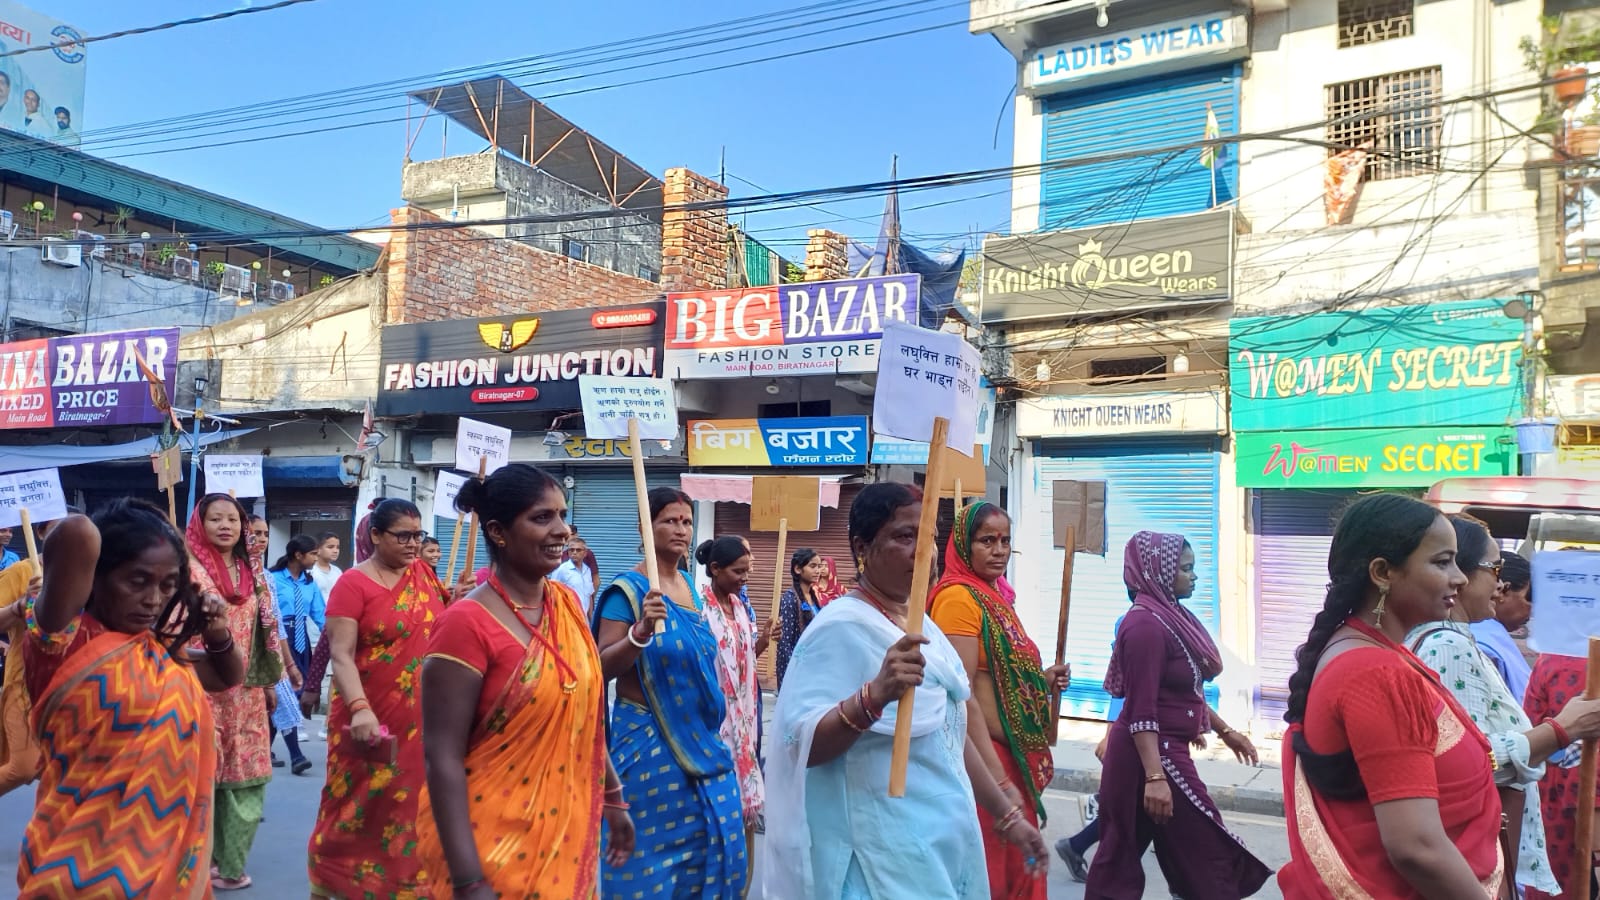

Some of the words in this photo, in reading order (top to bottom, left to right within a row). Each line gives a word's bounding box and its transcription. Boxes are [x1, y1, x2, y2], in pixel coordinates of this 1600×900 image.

[1038, 36, 1133, 77] LADIES
[1140, 18, 1226, 56] WEAR
[988, 262, 1069, 295] Knight
[1070, 249, 1193, 290] Queen
[671, 292, 775, 344] BIG
[786, 281, 909, 339] BAZAR
[0, 349, 48, 390] INA
[52, 337, 168, 387] BAZAR
[698, 348, 789, 363] FASHION
[802, 343, 876, 359] STORE
[725, 363, 747, 372] MAIN
[900, 344, 940, 363] लघुवित्त
[1387, 333, 1525, 392] SECRET
[383, 357, 498, 391] FASHION
[504, 347, 657, 384] JUNCTION
[903, 366, 920, 380] घर
[56, 389, 119, 409] PRICE
[6, 412, 26, 423] Main
[27, 411, 48, 423] Road
[58, 409, 111, 423] Biratnagar-7
[1053, 406, 1093, 428] KNIGHT
[1095, 405, 1131, 427] QUEEN
[1134, 402, 1172, 425] WEARS
[690, 421, 757, 450] बिग
[766, 426, 862, 454] बजार
